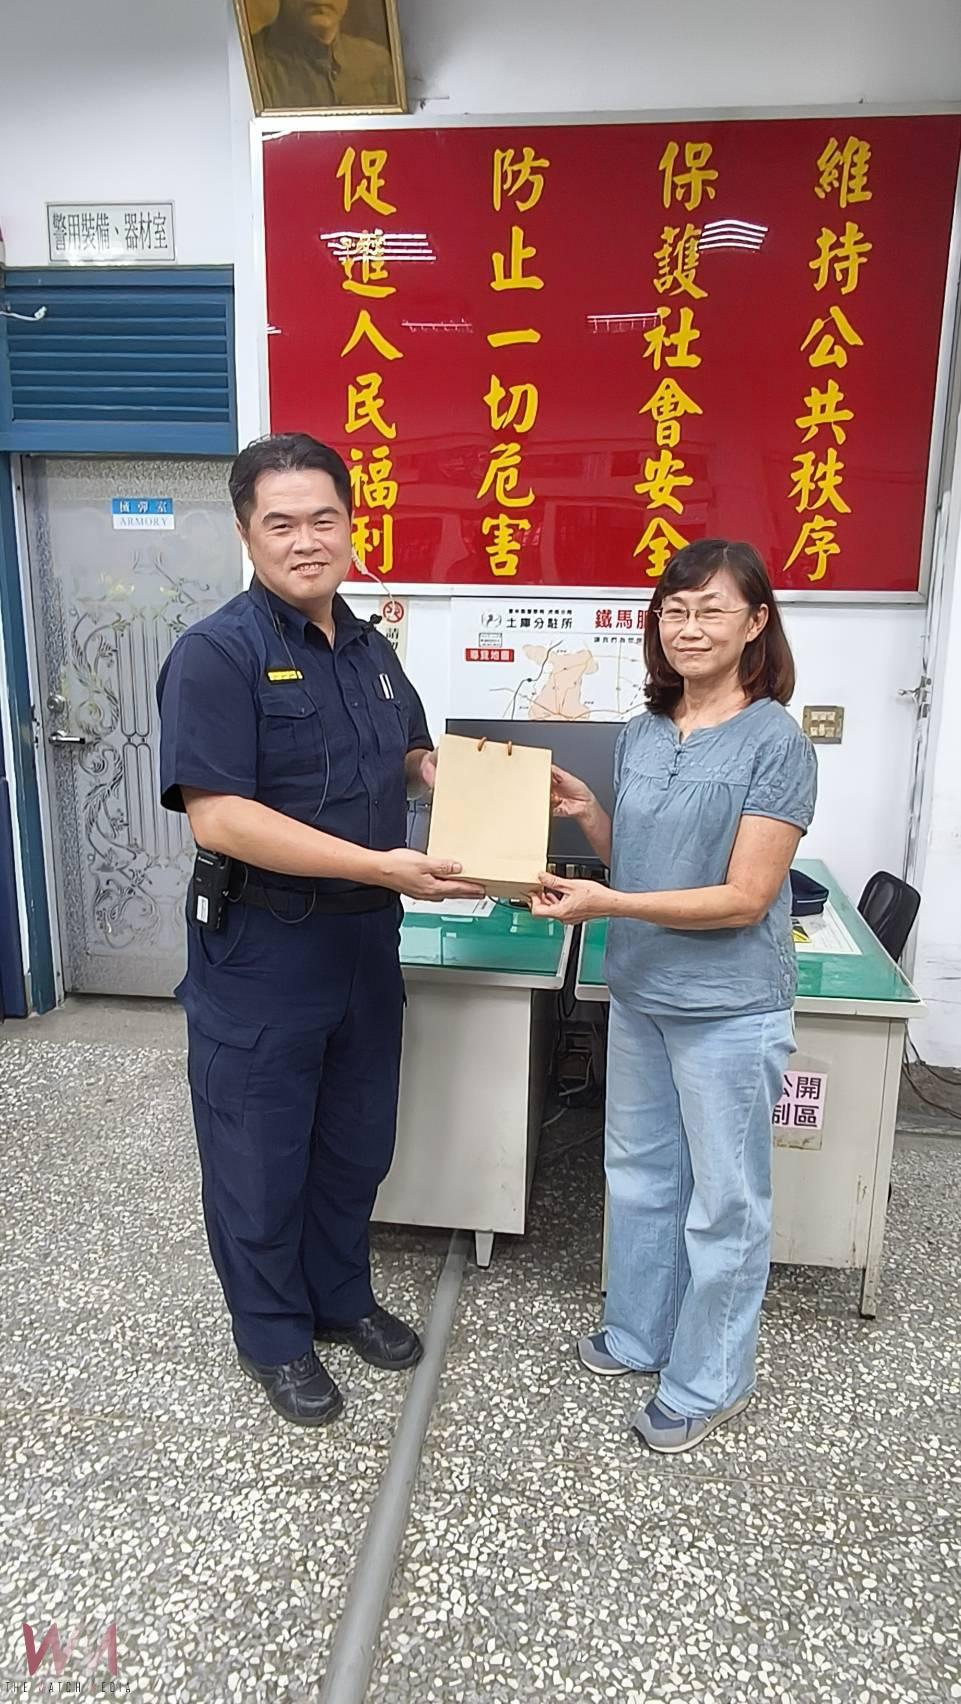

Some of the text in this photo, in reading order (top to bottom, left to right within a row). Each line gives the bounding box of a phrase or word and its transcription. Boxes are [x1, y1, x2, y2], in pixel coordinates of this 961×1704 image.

[52, 211, 169, 250] 警用裝備、器材室
[335, 146, 404, 575] 促進人民福利
[478, 147, 551, 577] 防止一切危害
[634, 140, 720, 580] 保護社會安全
[783, 134, 874, 584] 維持公共秩序
[119, 516, 168, 527] ARMORY
[506, 617, 573, 630] 土庫分駐所
